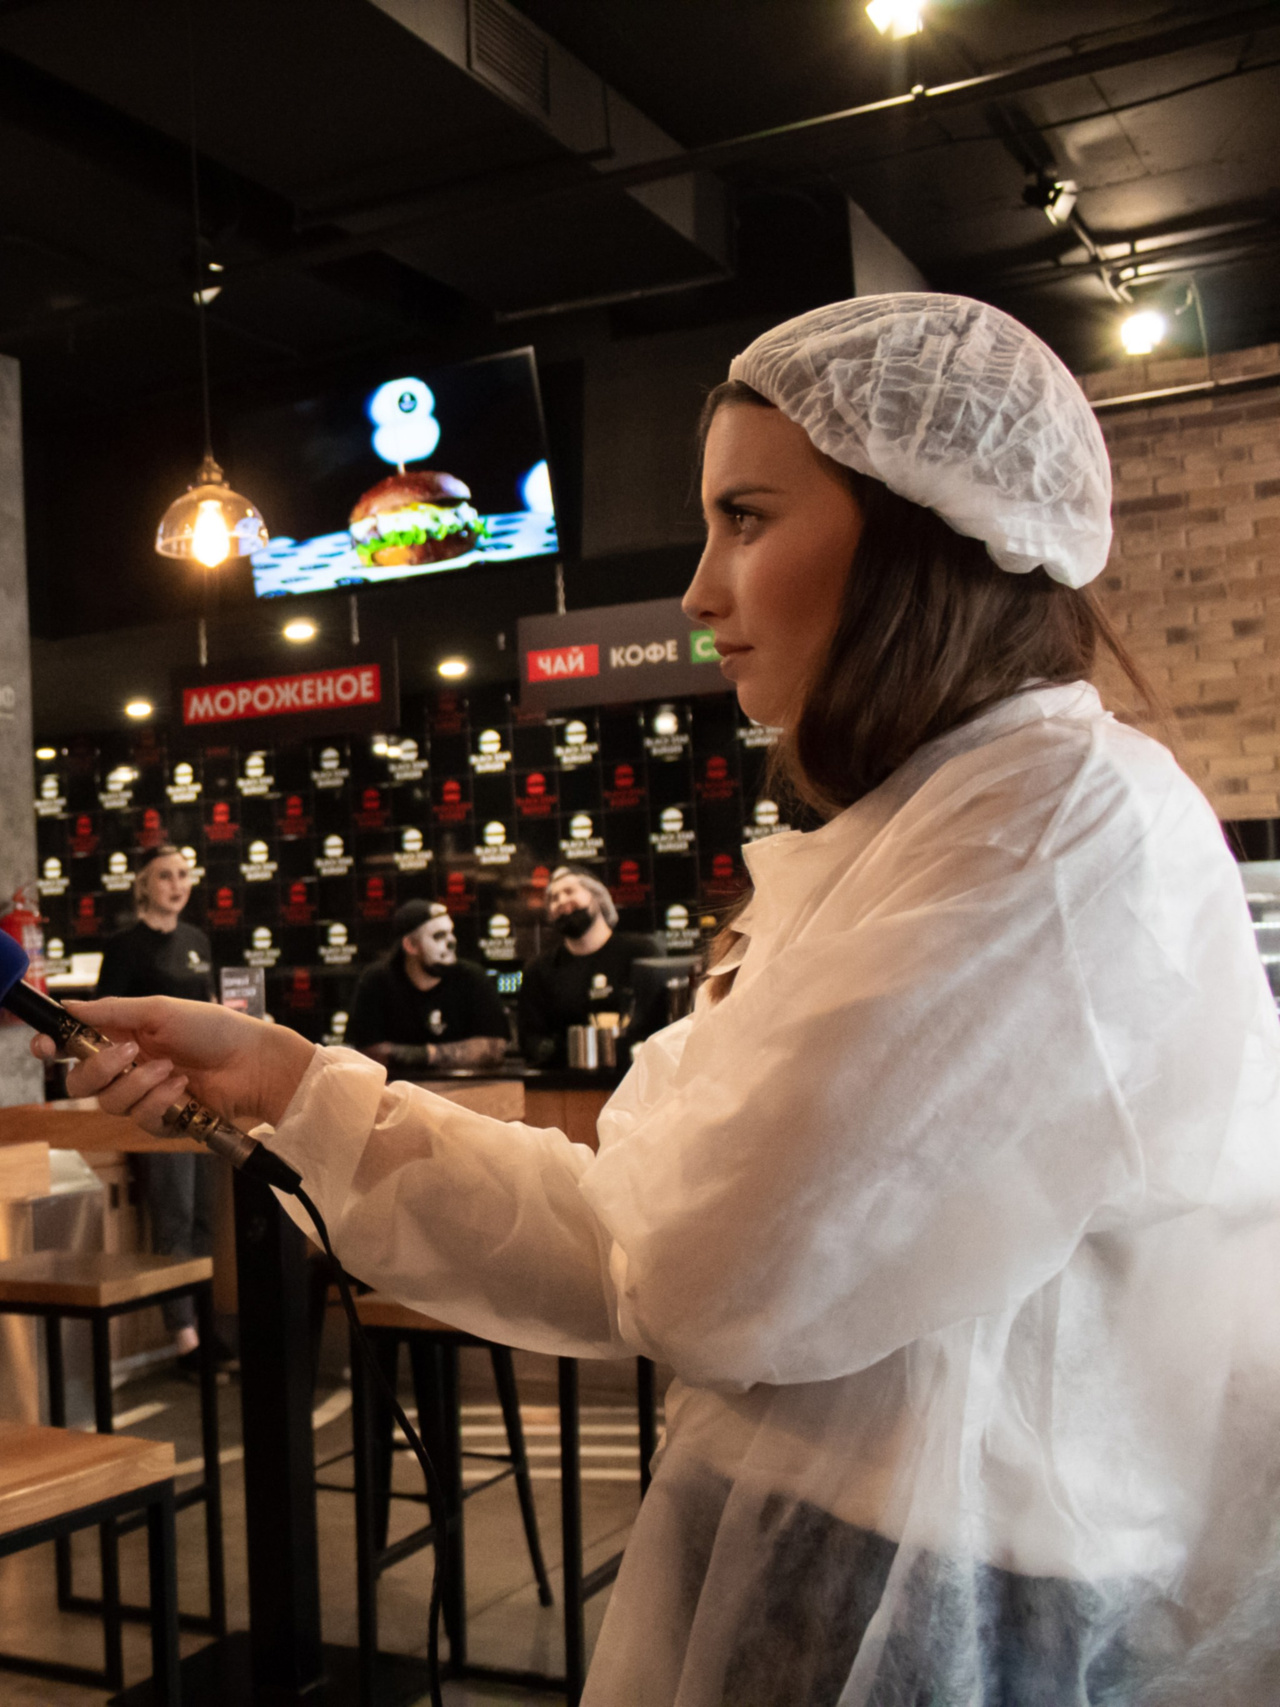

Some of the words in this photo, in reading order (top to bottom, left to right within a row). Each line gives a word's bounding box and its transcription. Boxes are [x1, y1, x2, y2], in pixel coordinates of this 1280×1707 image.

[537, 647, 585, 676] ЧАЙ
[610, 640, 678, 668] КОФЕ
[189, 671, 375, 720] МОРОЖЕНОЕ
